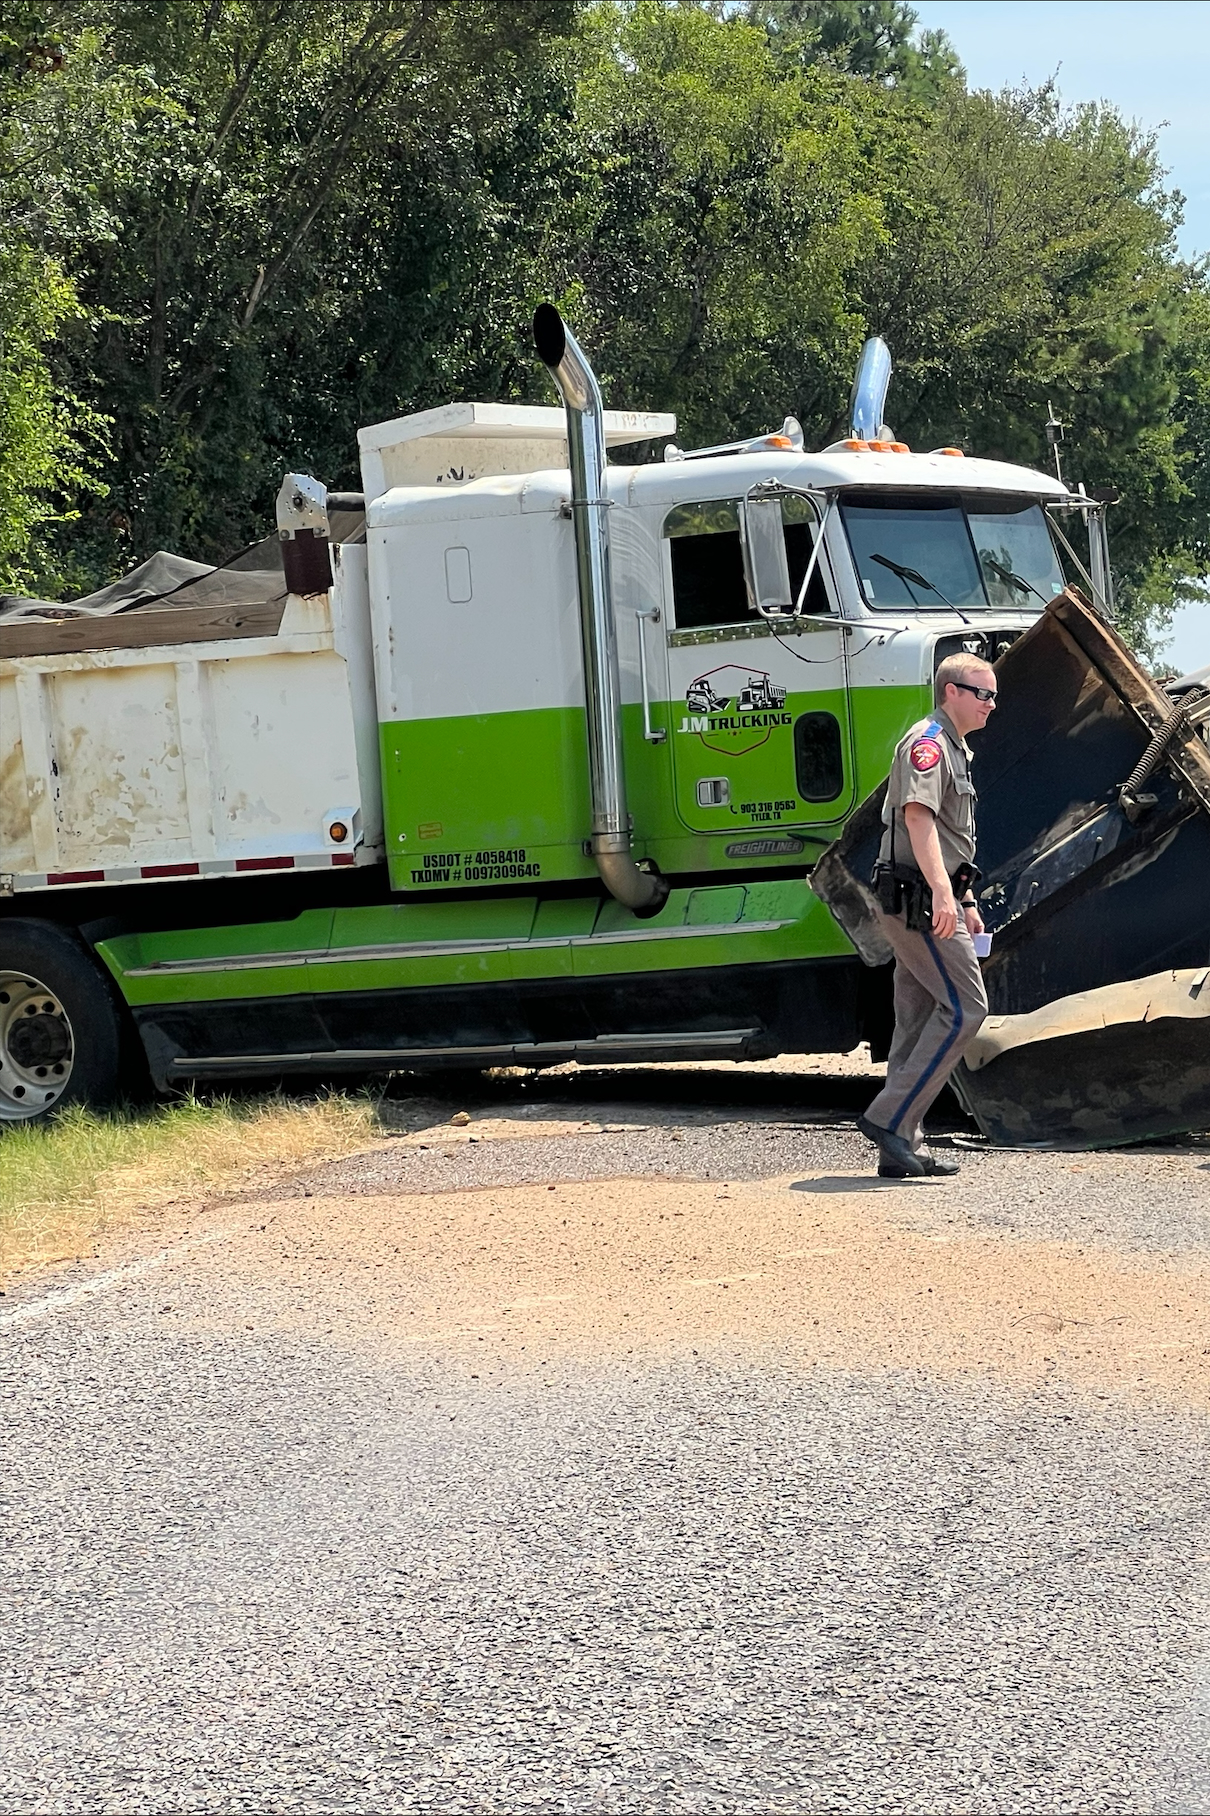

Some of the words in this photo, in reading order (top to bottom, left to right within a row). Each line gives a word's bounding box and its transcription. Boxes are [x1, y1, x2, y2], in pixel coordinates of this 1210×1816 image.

[708, 713, 792, 731] TRUCKING
[740, 802, 756, 814] 903
[758, 802, 773, 812] 316
[774, 800, 796, 811] 0563
[773, 811, 782, 820] TX
[728, 841, 800, 856] FREIGHTLINER
[423, 853, 461, 868] USDOT
[463, 854, 473, 866] #
[475, 849, 526, 865] 4058418
[411, 868, 450, 883] TXDMV
[453, 869, 462, 881] #
[464, 863, 540, 881] 009730964C
